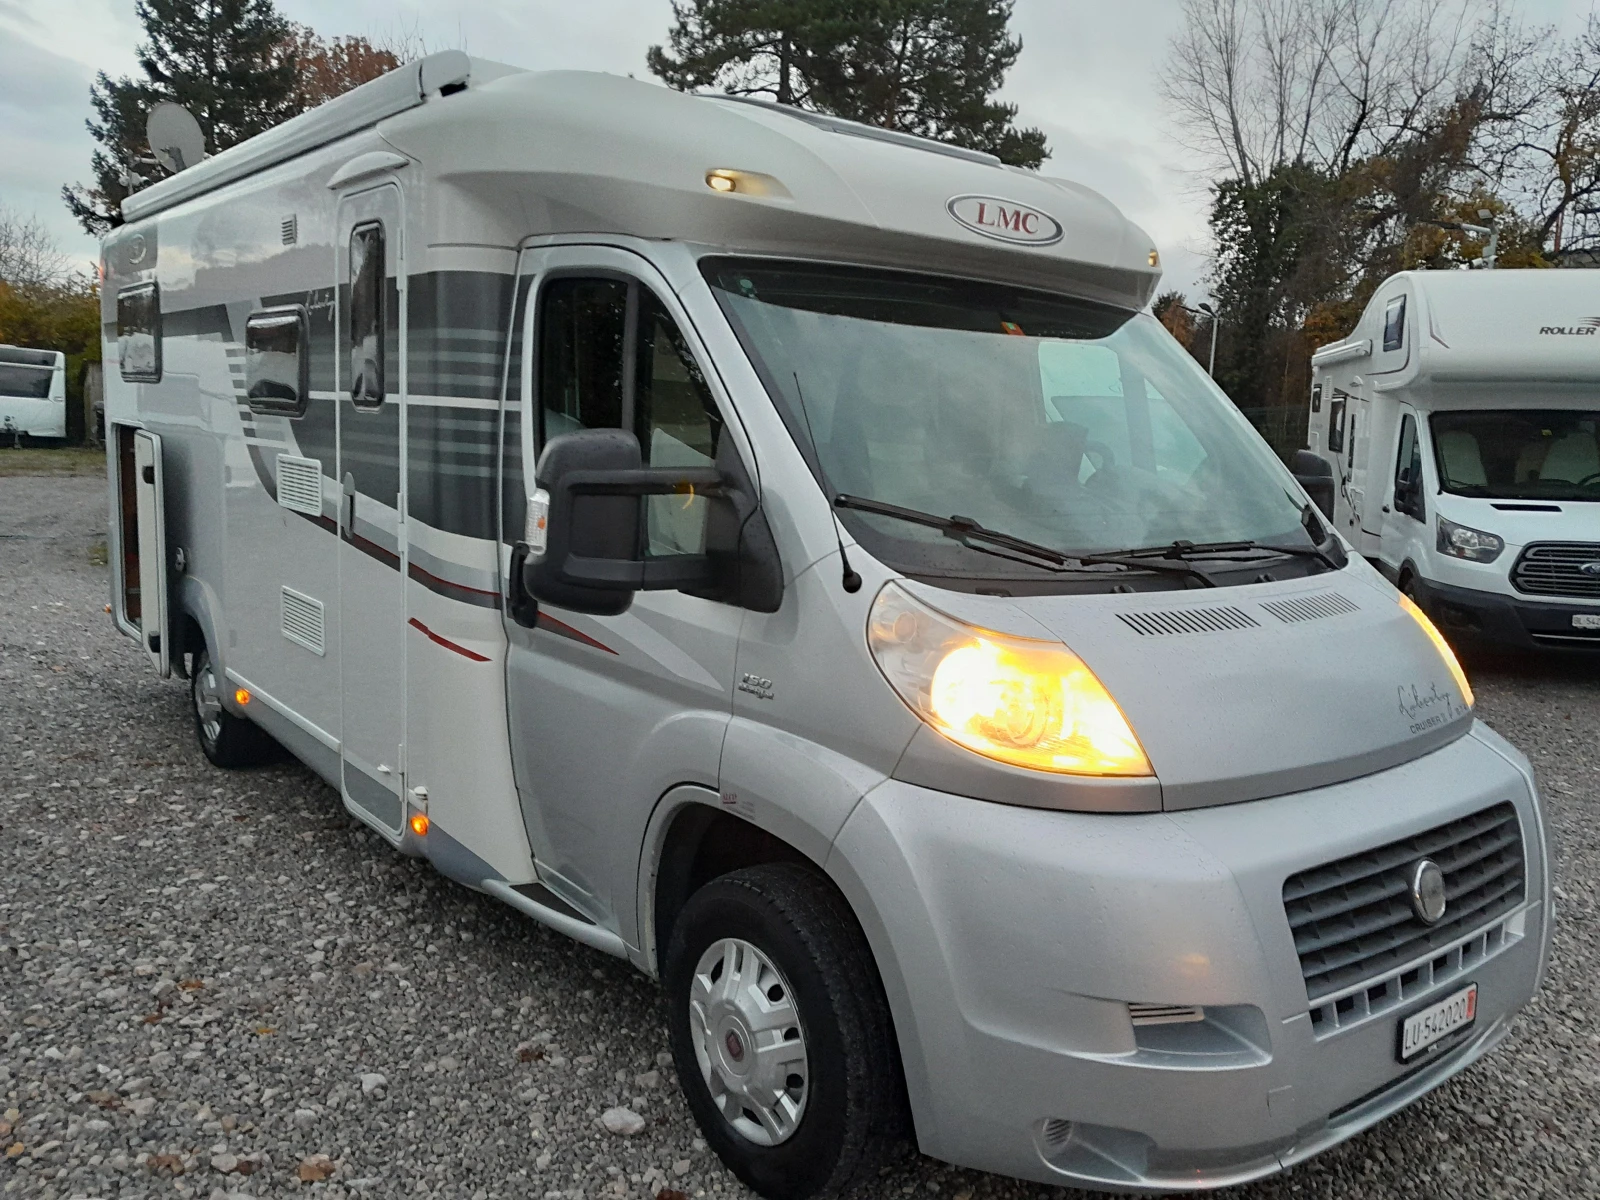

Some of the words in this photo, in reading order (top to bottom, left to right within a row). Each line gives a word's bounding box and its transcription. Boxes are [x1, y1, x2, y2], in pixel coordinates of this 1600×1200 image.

[976, 201, 1039, 234] LMC
[1539, 326, 1597, 335] ROLLER
[1409, 715, 1442, 735] CRUISER
